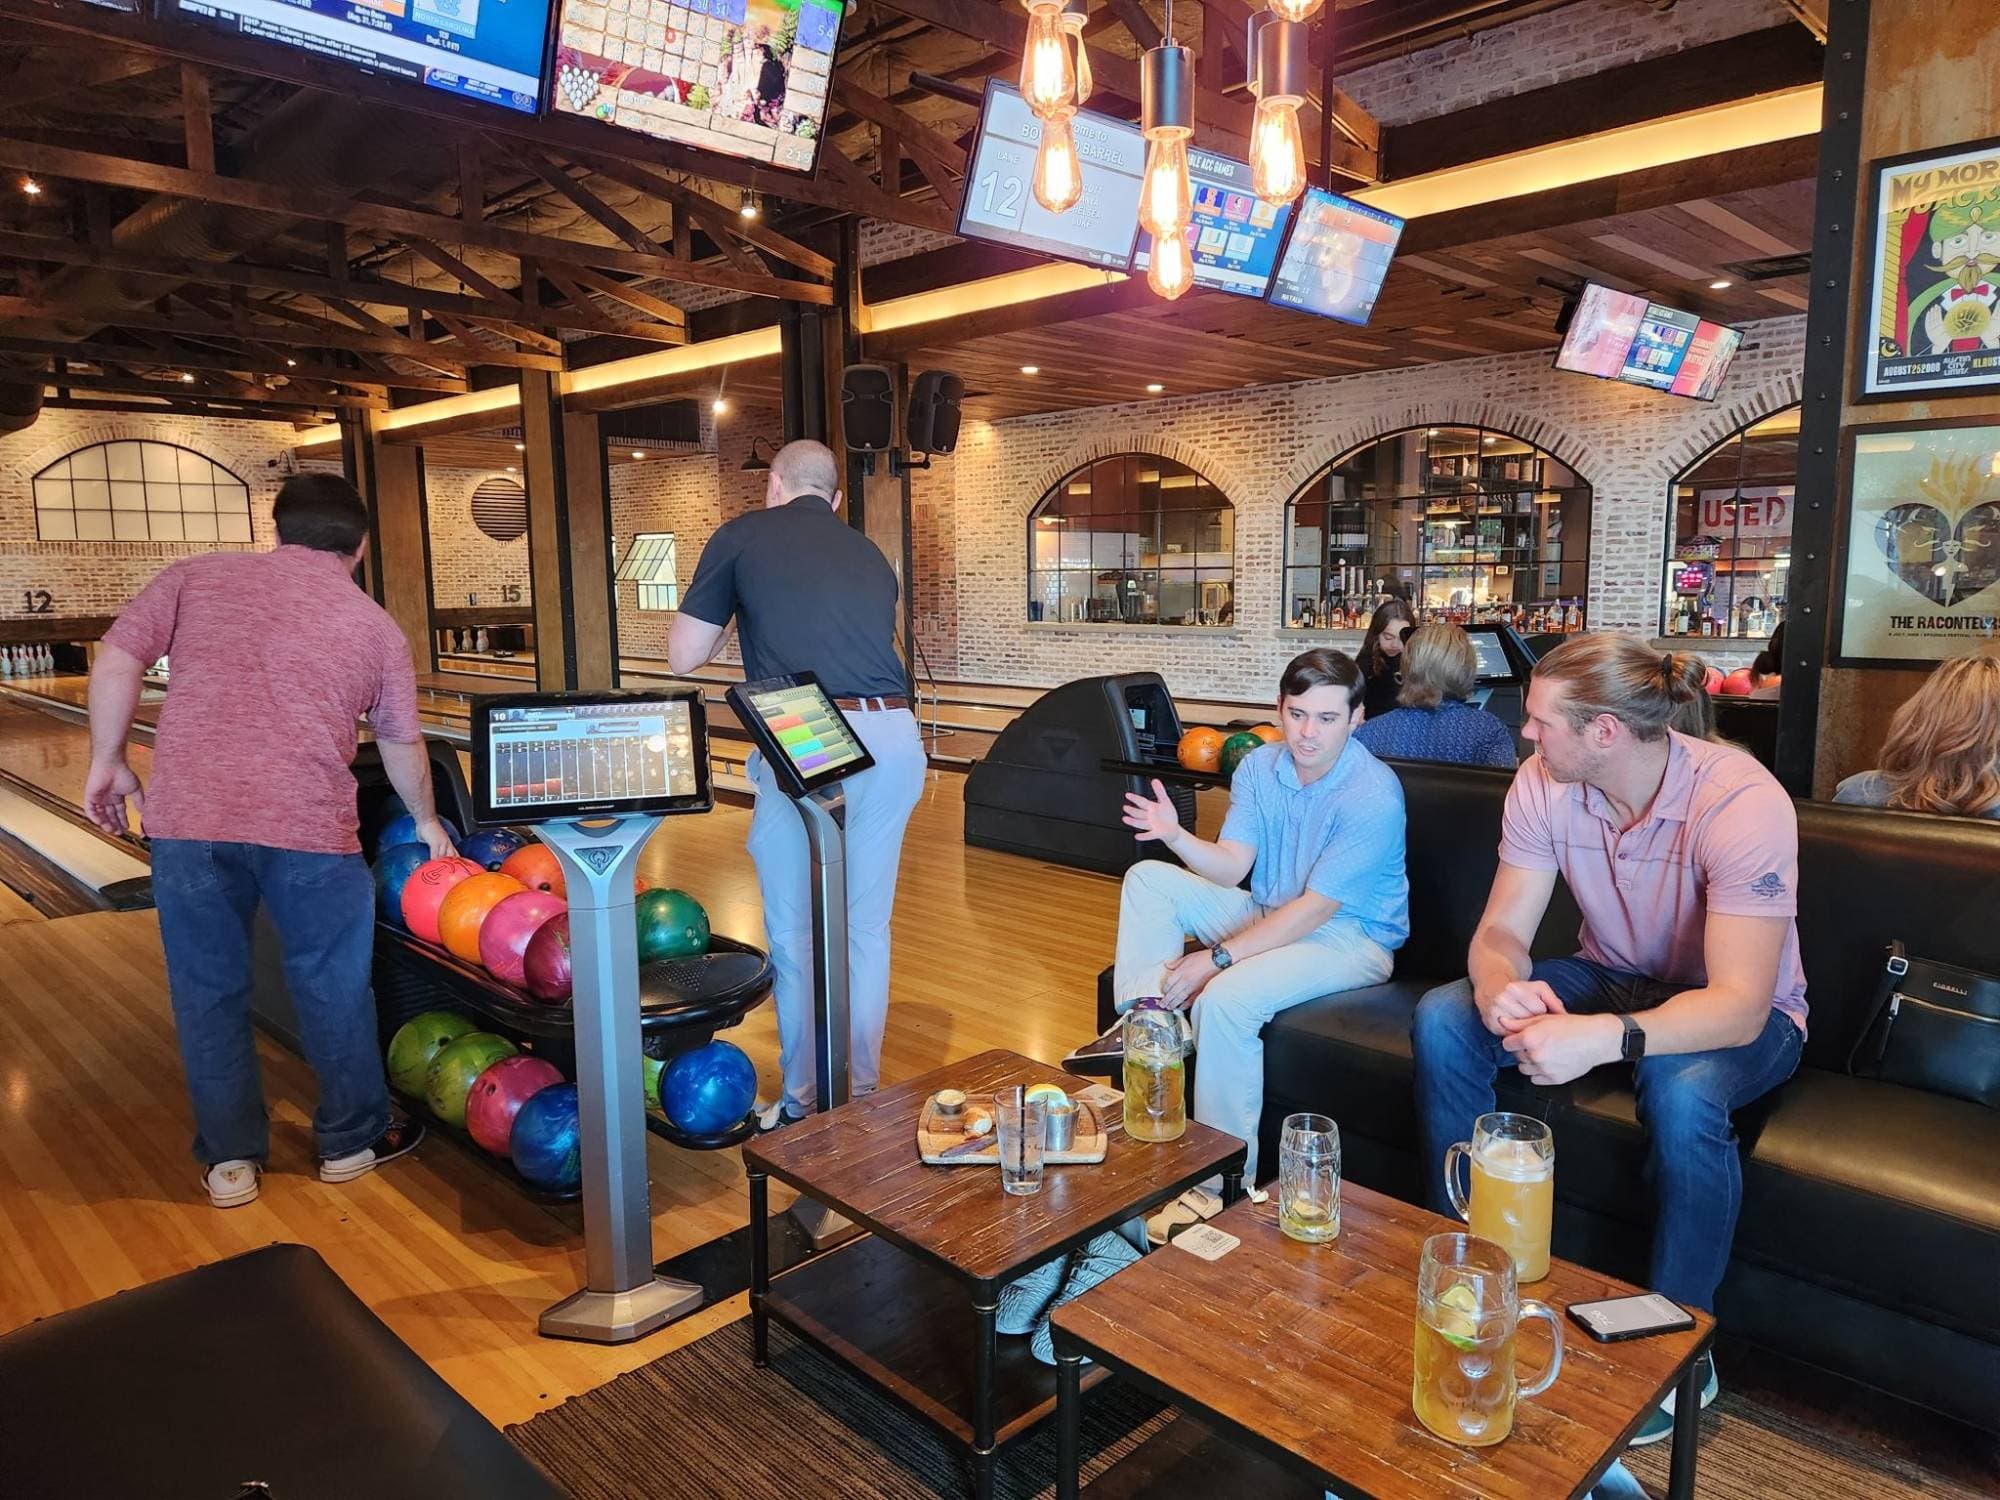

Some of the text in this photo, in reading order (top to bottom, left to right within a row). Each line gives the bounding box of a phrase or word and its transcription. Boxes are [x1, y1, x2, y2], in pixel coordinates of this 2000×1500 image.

[1098, 127, 1108, 142] to
[786, 147, 812, 163] 219
[997, 151, 1020, 165] LANE
[1082, 142, 1125, 166] BARREL
[980, 170, 1023, 218] 12
[24, 590, 53, 613] 12
[500, 584, 521, 603] 15
[1890, 616, 1914, 629] THE
